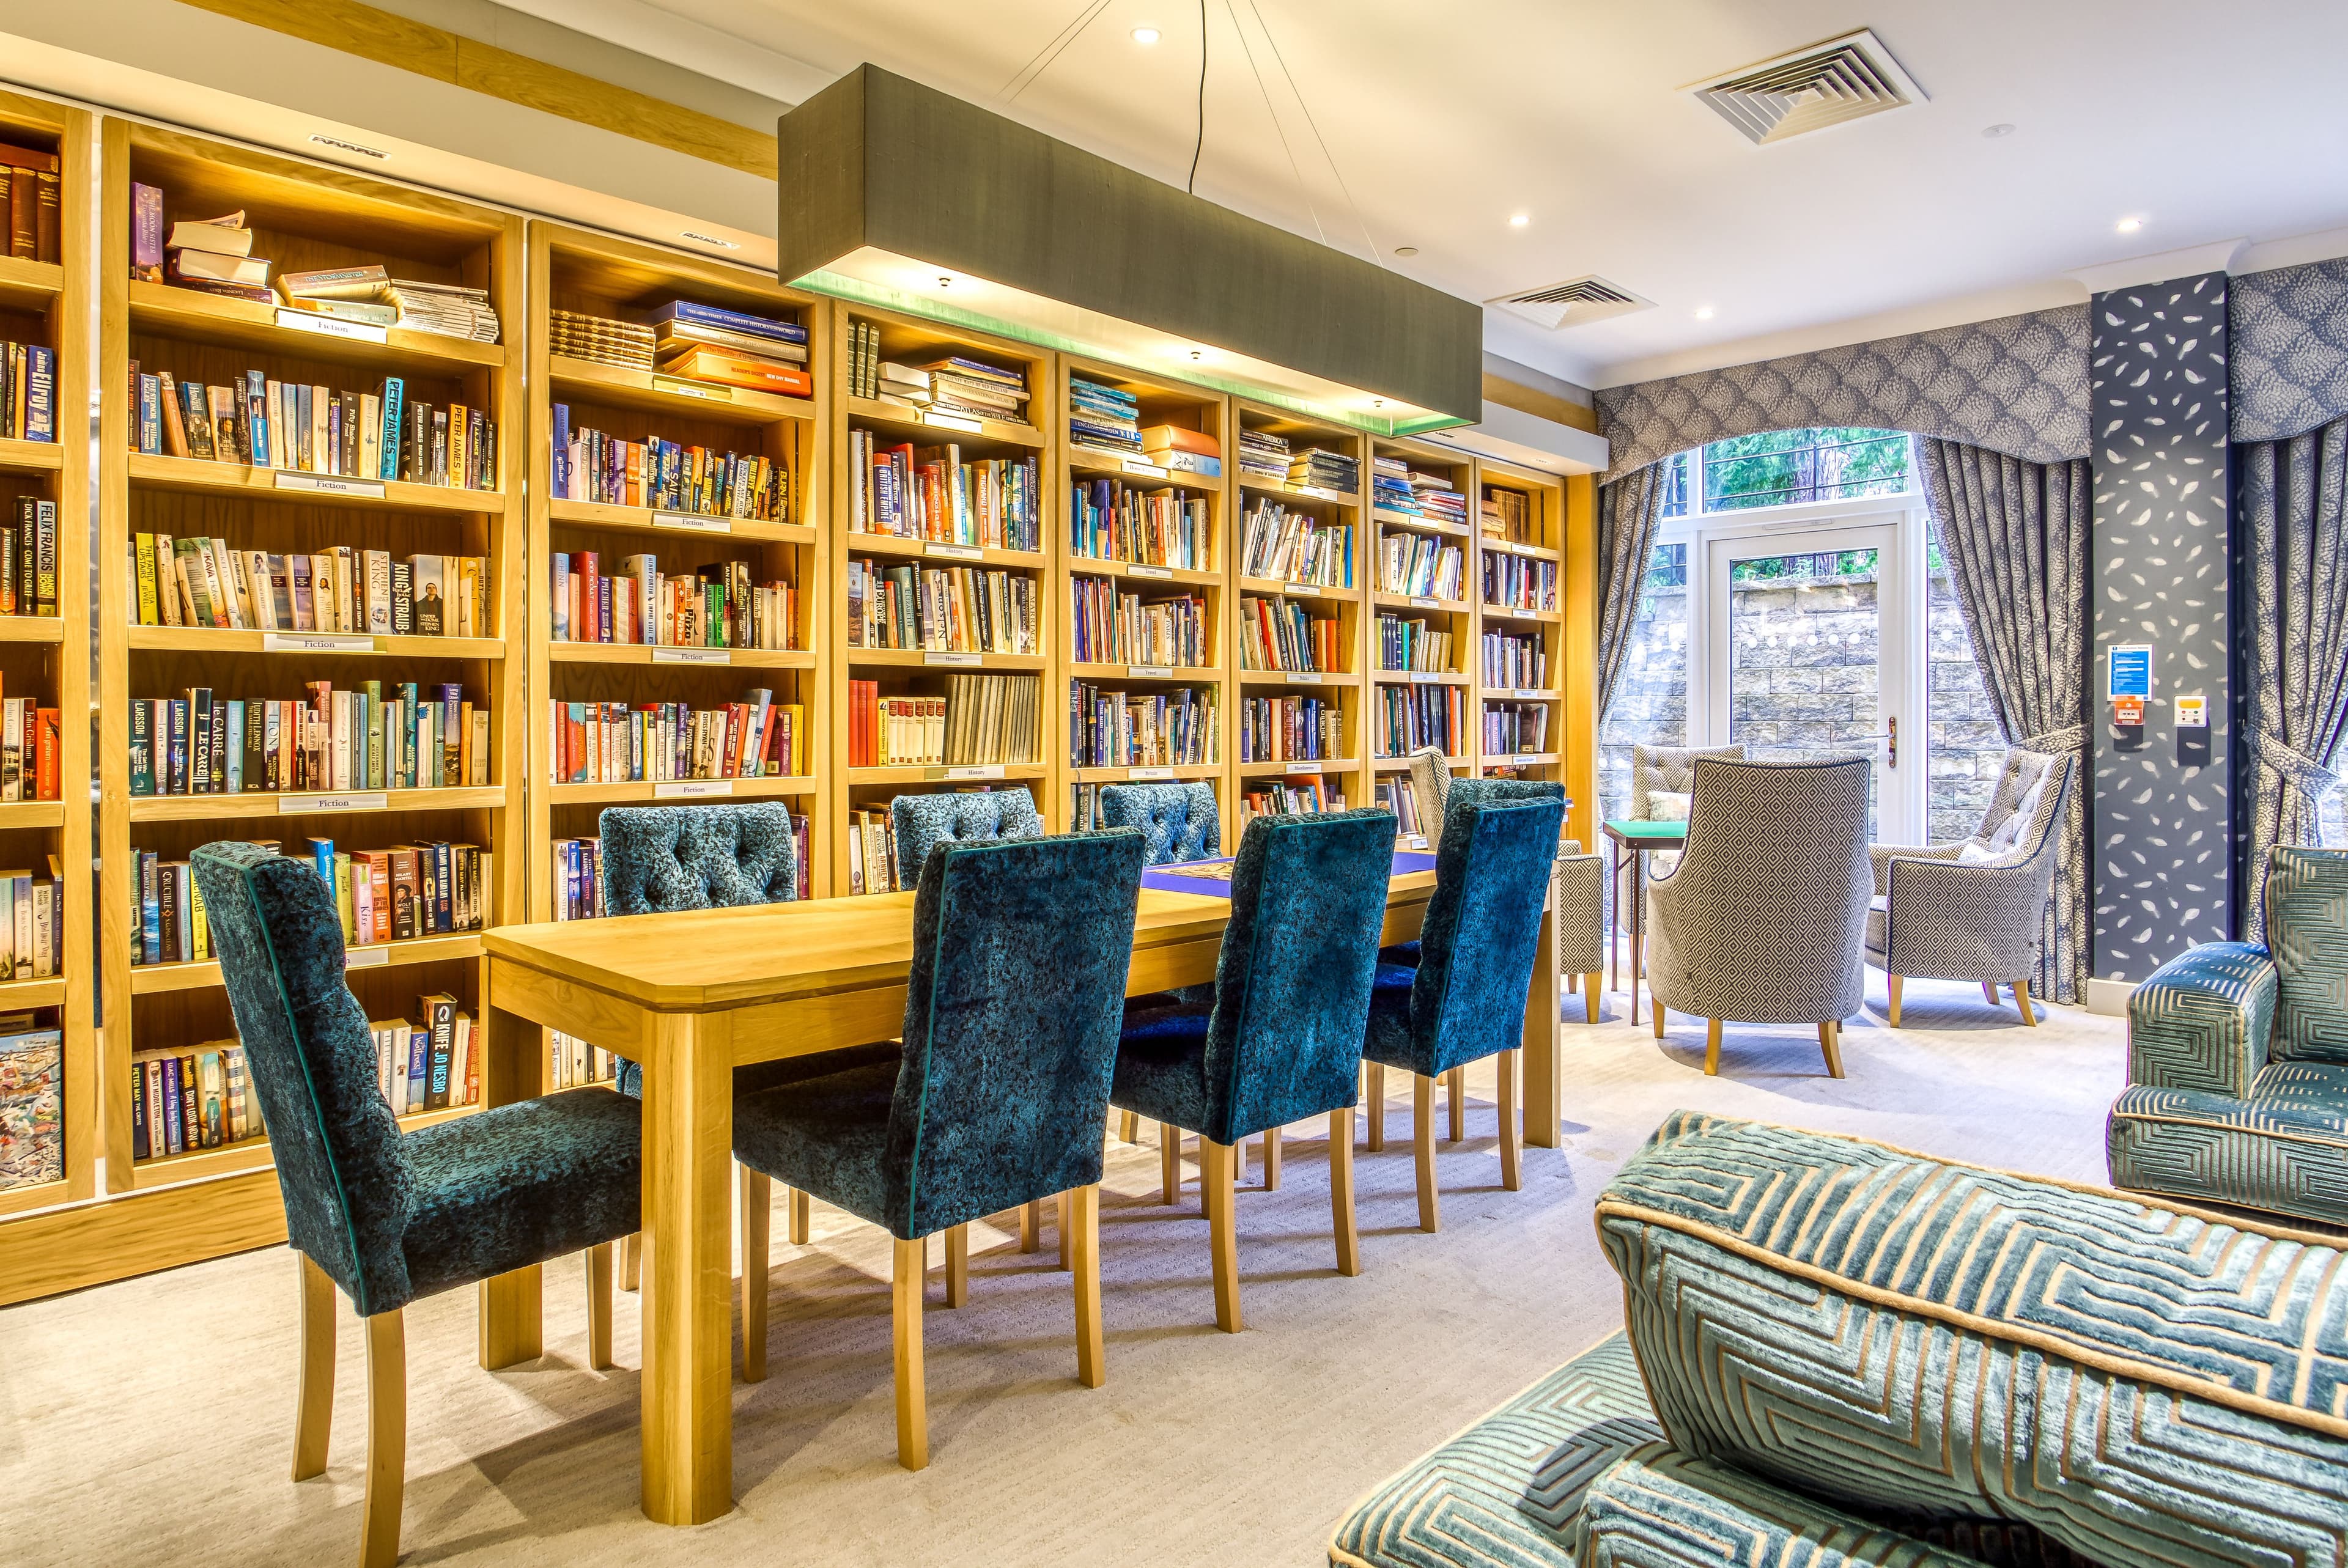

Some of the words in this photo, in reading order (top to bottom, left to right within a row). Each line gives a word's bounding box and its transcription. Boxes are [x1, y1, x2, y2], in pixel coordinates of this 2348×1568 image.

[319, 321, 349, 333] Fiction
[724, 316, 749, 325] COMPLETE
[750, 321, 770, 329] HISTORY
[37, 351, 47, 373] James
[29, 372, 51, 411] Ellroy
[389, 381, 399, 415] PETER
[386, 418, 397, 454] JAMES
[1262, 435, 1283, 445] AMERICA
[317, 480, 347, 490] Fiction
[670, 472, 679, 497] SAIL
[879, 469, 888, 494] BRITISH
[41, 505, 53, 529] FELIX
[880, 497, 889, 519] EMPIRE
[41, 532, 53, 571] FRANCIS
[24, 570, 32, 578] TO
[204, 556, 215, 578] KAVA
[371, 559, 380, 589] KING
[394, 564, 408, 587] KING
[24, 579, 32, 597] GRIEF
[395, 597, 409, 630] STRAUB
[876, 590, 885, 624] EUROPE
[904, 589, 913, 627] ELIZABETH
[305, 640, 336, 649] Fiction
[25, 711, 34, 728] John
[135, 703, 145, 734] LARSSON
[174, 704, 184, 734] LARSSON
[213, 707, 224, 715] le
[253, 702, 262, 724] JUDITH
[199, 731, 209, 744] LE
[253, 726, 262, 751] LENNOX
[269, 714, 279, 746] LEON
[25, 729, 34, 759] Grisham
[319, 800, 350, 808] Fiction
[163, 871, 172, 909] CRUCIBLE
[360, 906, 370, 926] Kiss
[435, 1023, 451, 1050] KNIFE
[435, 1052, 448, 1063] JO
[133, 1067, 141, 1087] PETER
[185, 1091, 194, 1106] DON'T
[186, 1108, 196, 1123] LOOK
[188, 1126, 198, 1141] NOW
